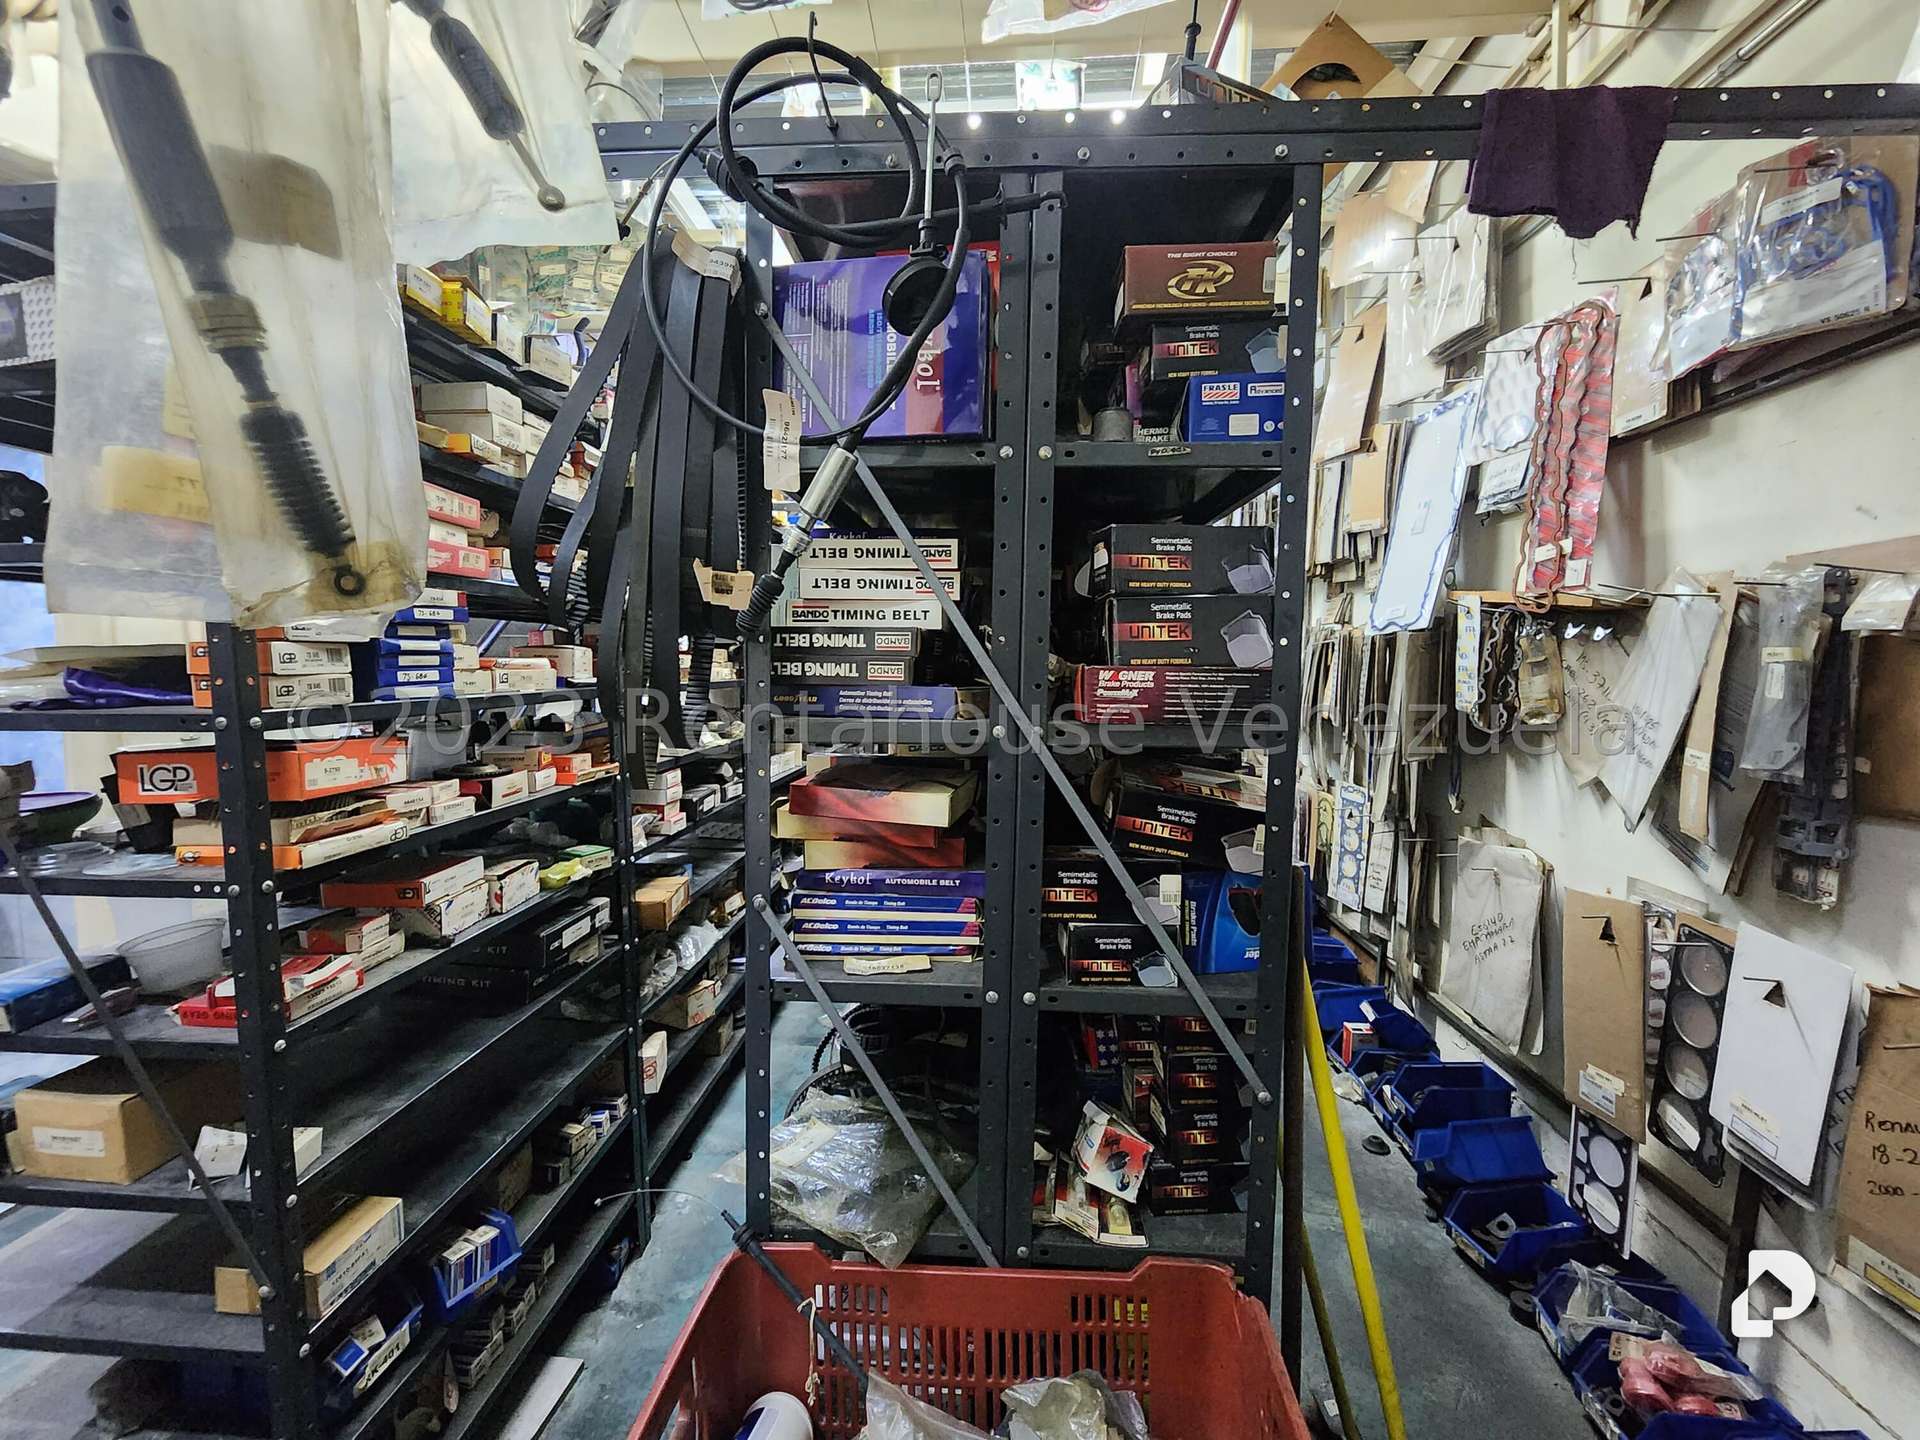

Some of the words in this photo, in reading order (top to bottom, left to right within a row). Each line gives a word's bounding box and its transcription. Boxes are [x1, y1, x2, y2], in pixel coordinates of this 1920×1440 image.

[1168, 341, 1217, 356] UNITEK
[1151, 537, 1193, 545] Semimetallic
[810, 548, 848, 558] BELT
[1176, 544, 1192, 552] Pads
[1129, 556, 1191, 569] UNITEK
[812, 578, 850, 588] BELT
[857, 578, 913, 589] TIMING
[1150, 603, 1192, 611] Semimetallic
[792, 609, 829, 619] BANDO
[831, 610, 886, 621] TIMING
[892, 610, 931, 621] BELT
[1176, 611, 1192, 619] Pads
[1129, 625, 1191, 639] UNITEK
[773, 633, 810, 647] BELT
[812, 633, 867, 648] TIMING
[876, 637, 910, 646] BANDO
[279, 652, 297, 664] LGP
[804, 661, 859, 677] TIMING
[868, 666, 903, 675] BANDO
[1099, 670, 1155, 681] WAGNER
[276, 685, 295, 697] LGP
[139, 766, 191, 793] LGP
[1157, 805, 1198, 818] Semimetallic
[1161, 813, 1182, 822] Brake
[1183, 816, 1196, 825] Pads
[1132, 820, 1191, 841] UNITEK
[1058, 871, 1098, 879] Semimetallic
[885, 878, 937, 886] AUTOMOBILE
[939, 879, 961, 887] BELT
[801, 897, 837, 905] ACDelco
[802, 922, 839, 930] ACDelco
[1081, 961, 1132, 972] UNITEK
